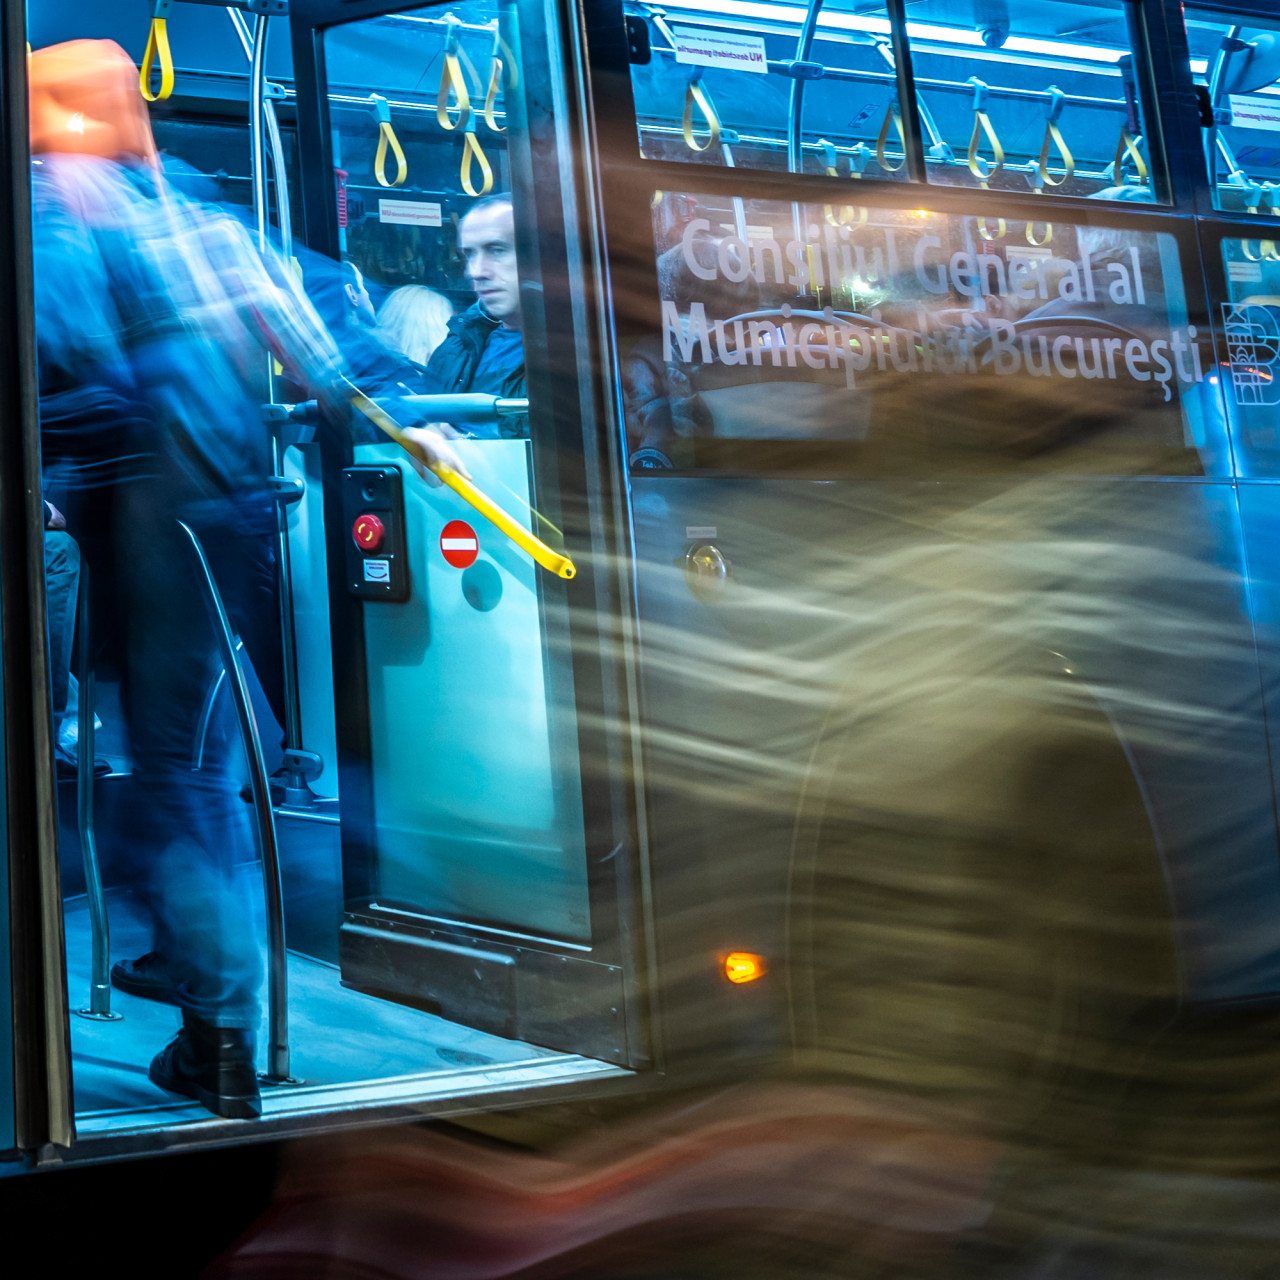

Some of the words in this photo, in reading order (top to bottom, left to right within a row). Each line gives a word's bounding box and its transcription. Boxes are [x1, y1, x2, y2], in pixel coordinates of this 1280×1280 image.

[682, 219, 899, 286] Consiliul
[914, 236, 1094, 305] General
[1107, 246, 1146, 306] al
[662, 300, 977, 388] Municipiului
